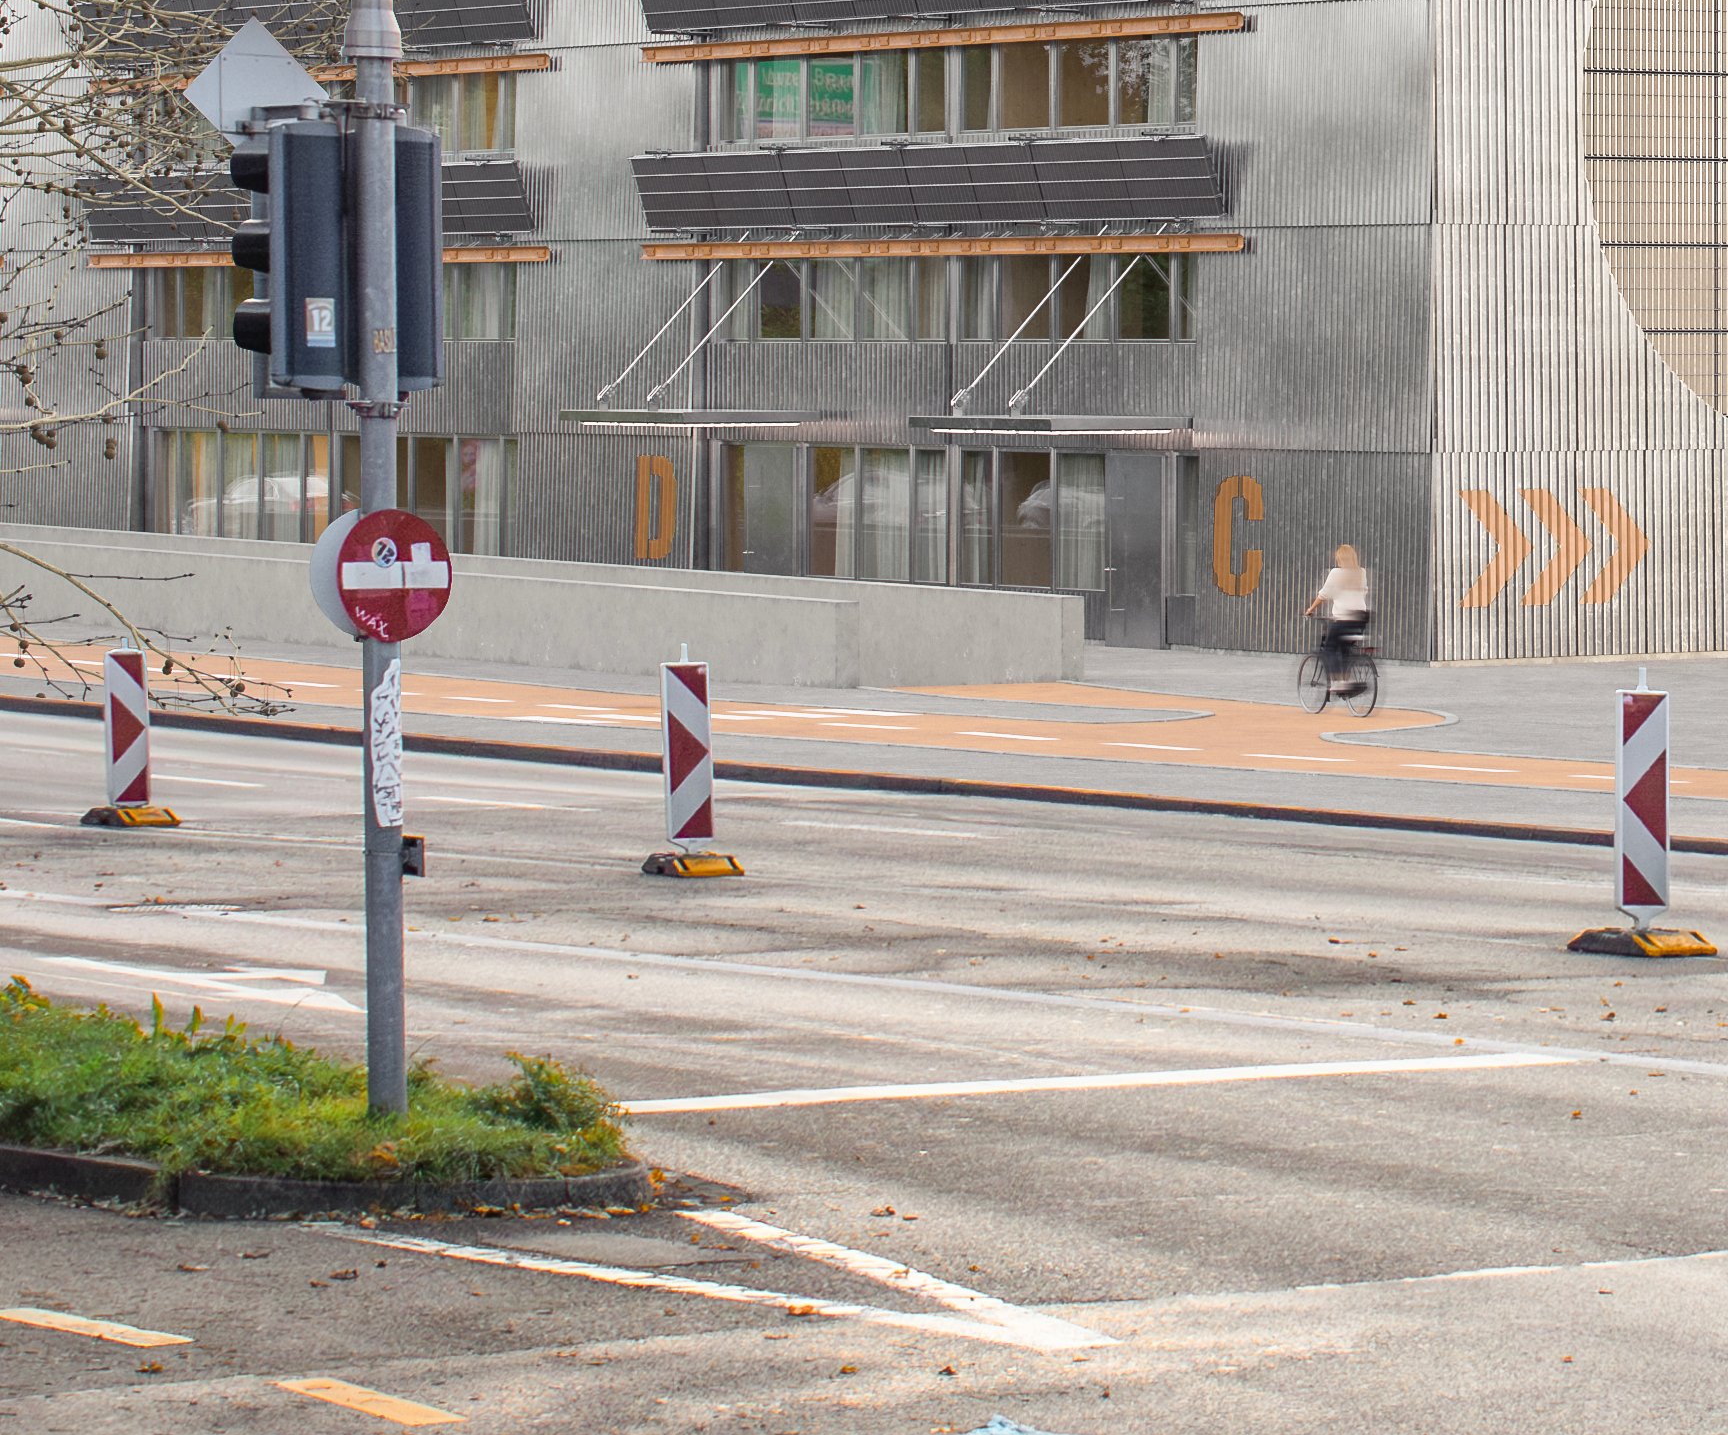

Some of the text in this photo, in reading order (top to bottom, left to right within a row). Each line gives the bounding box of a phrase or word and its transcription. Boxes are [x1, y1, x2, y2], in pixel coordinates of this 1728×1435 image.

[311, 309, 332, 331] 12
[634, 455, 676, 560] D
[1213, 475, 1263, 598] C
